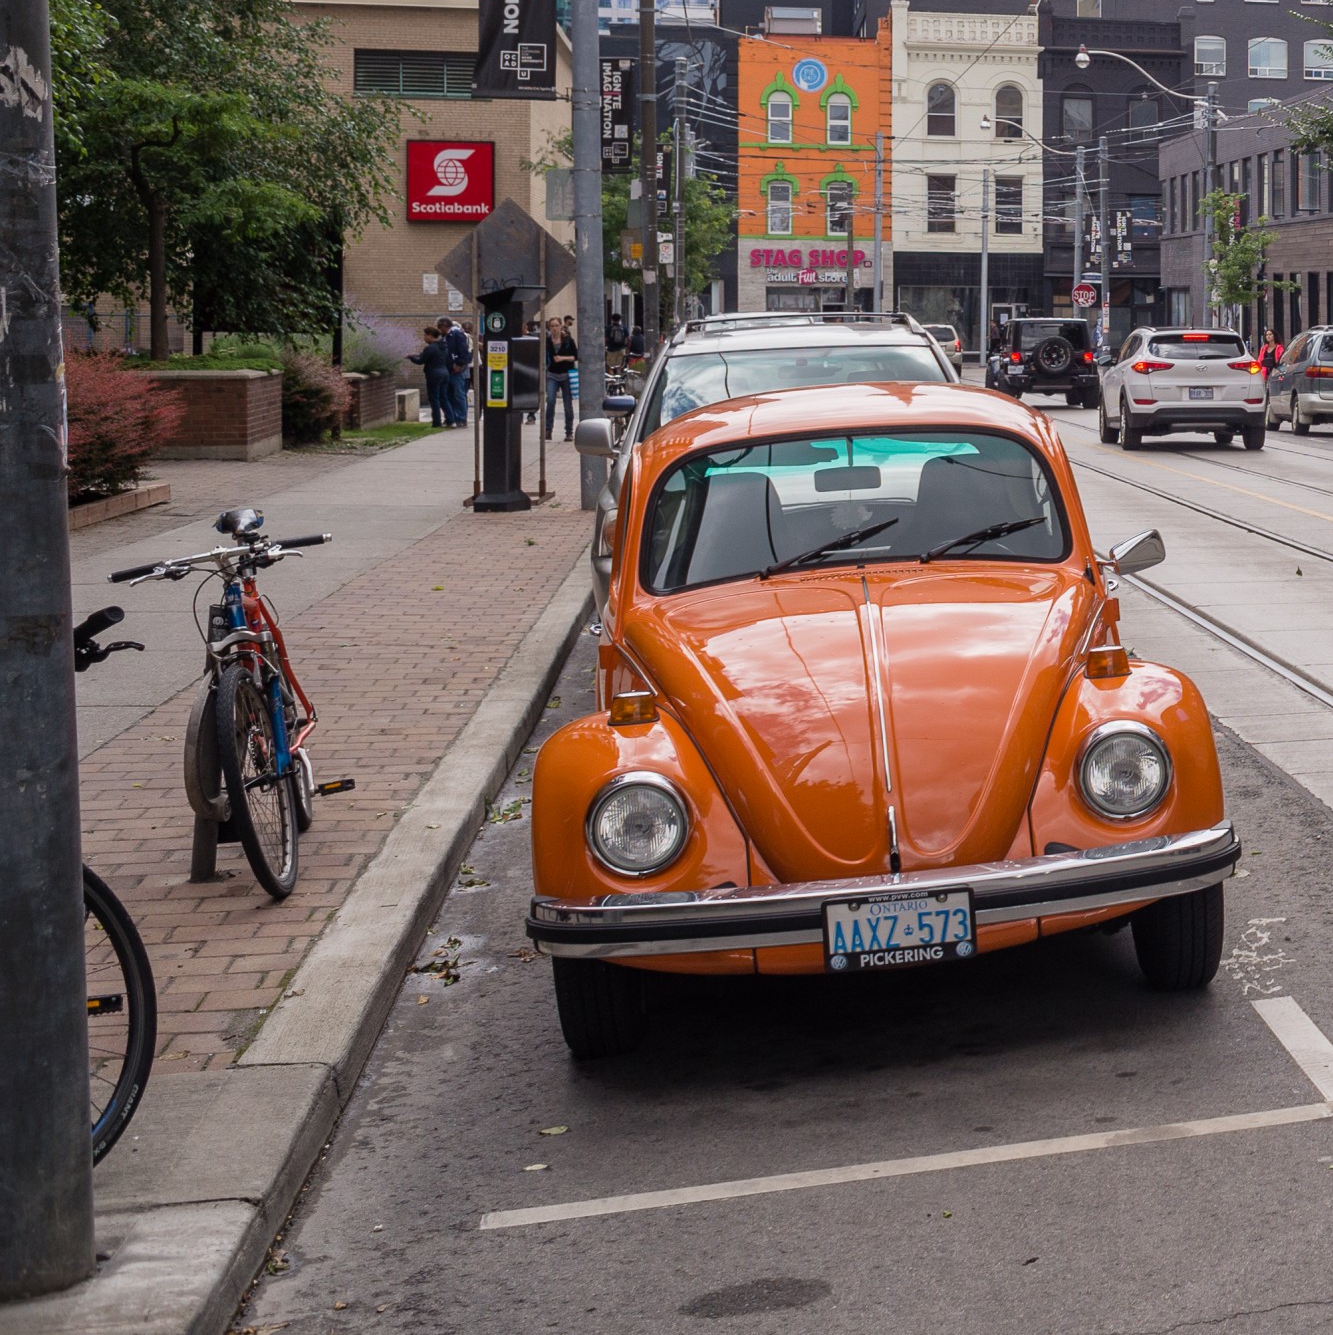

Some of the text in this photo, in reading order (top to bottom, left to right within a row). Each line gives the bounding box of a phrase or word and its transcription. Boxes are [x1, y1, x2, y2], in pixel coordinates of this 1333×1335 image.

[612, 71, 622, 110] IGNITE
[602, 62, 612, 139] IMAGINATION
[412, 202, 490, 214] Scotiabank
[750, 249, 866, 267] STAG SHOP
[767, 269, 849, 284] adult Fun store
[1073, 290, 1095, 300] STOP
[868, 891, 929, 903] www.pvw.com
[859, 946, 944, 968] PICKERING
[121, 1083, 139, 1120] GIANT
